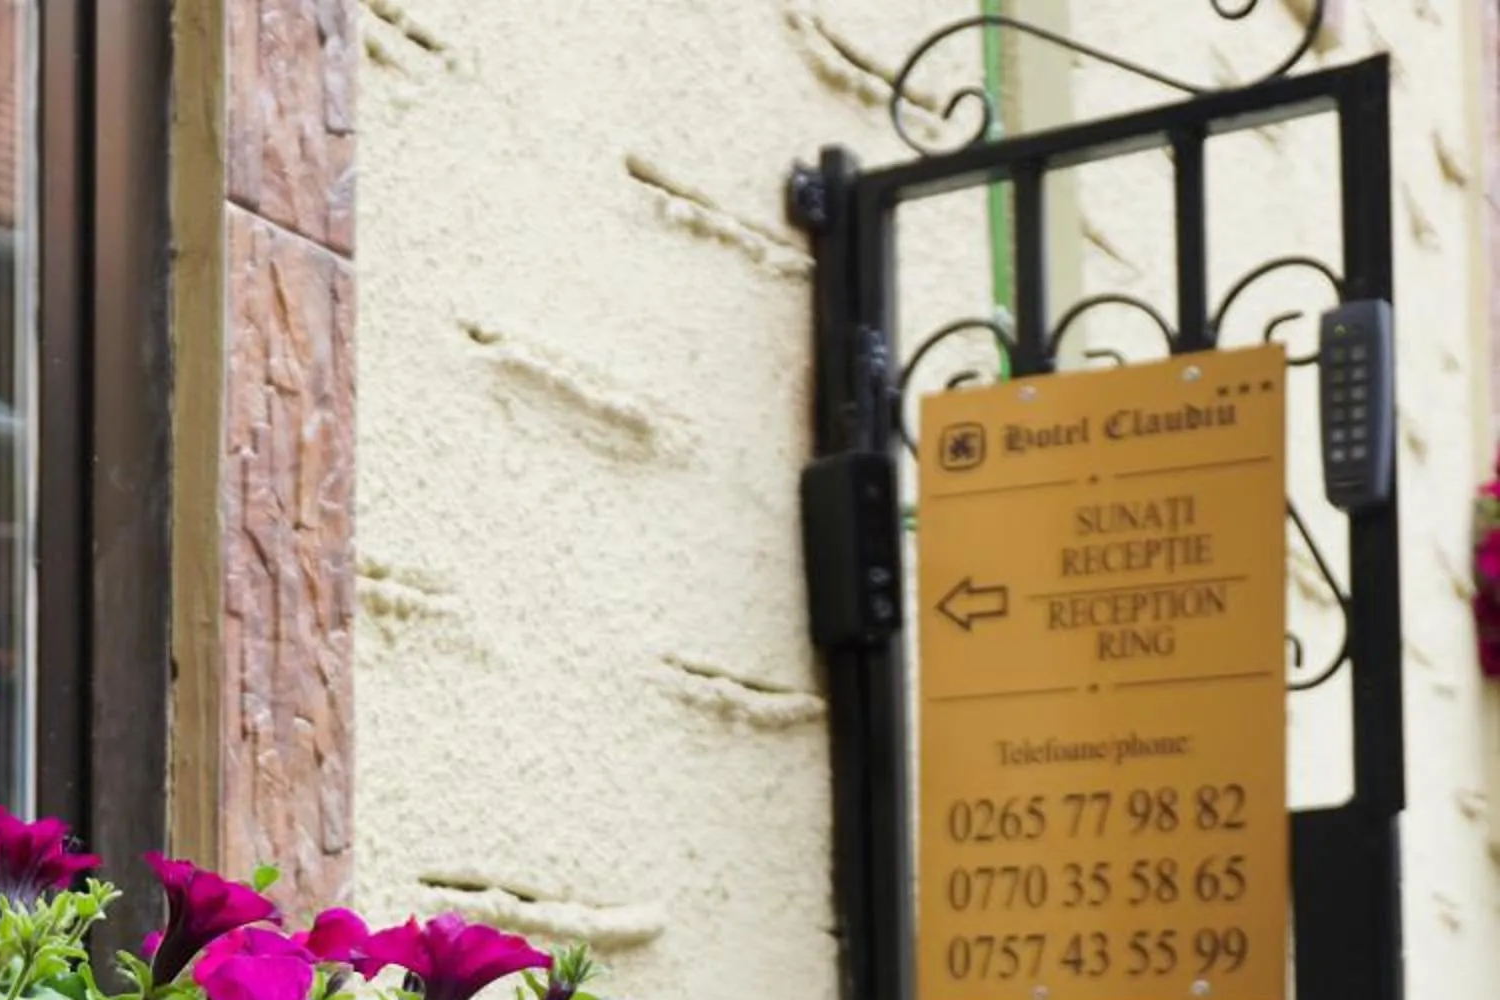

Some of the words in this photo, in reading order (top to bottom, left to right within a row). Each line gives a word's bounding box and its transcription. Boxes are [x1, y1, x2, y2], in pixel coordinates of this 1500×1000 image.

[1103, 403, 1238, 441] Claudiu
[1047, 585, 1227, 630] RECEPTION
[1097, 626, 1176, 661] RING
[948, 796, 1046, 842] 0265
[1063, 793, 1112, 838] 77
[1127, 787, 1180, 833] 98
[1193, 784, 1247, 831] 82
[947, 865, 1048, 911] 0770
[1062, 861, 1112, 906] 35
[1127, 858, 1180, 903] 58
[1193, 855, 1247, 901] 65
[947, 934, 1047, 980] 0757
[1060, 932, 1111, 977] 43
[1126, 930, 1178, 976] 55
[1193, 927, 1248, 973] 99
